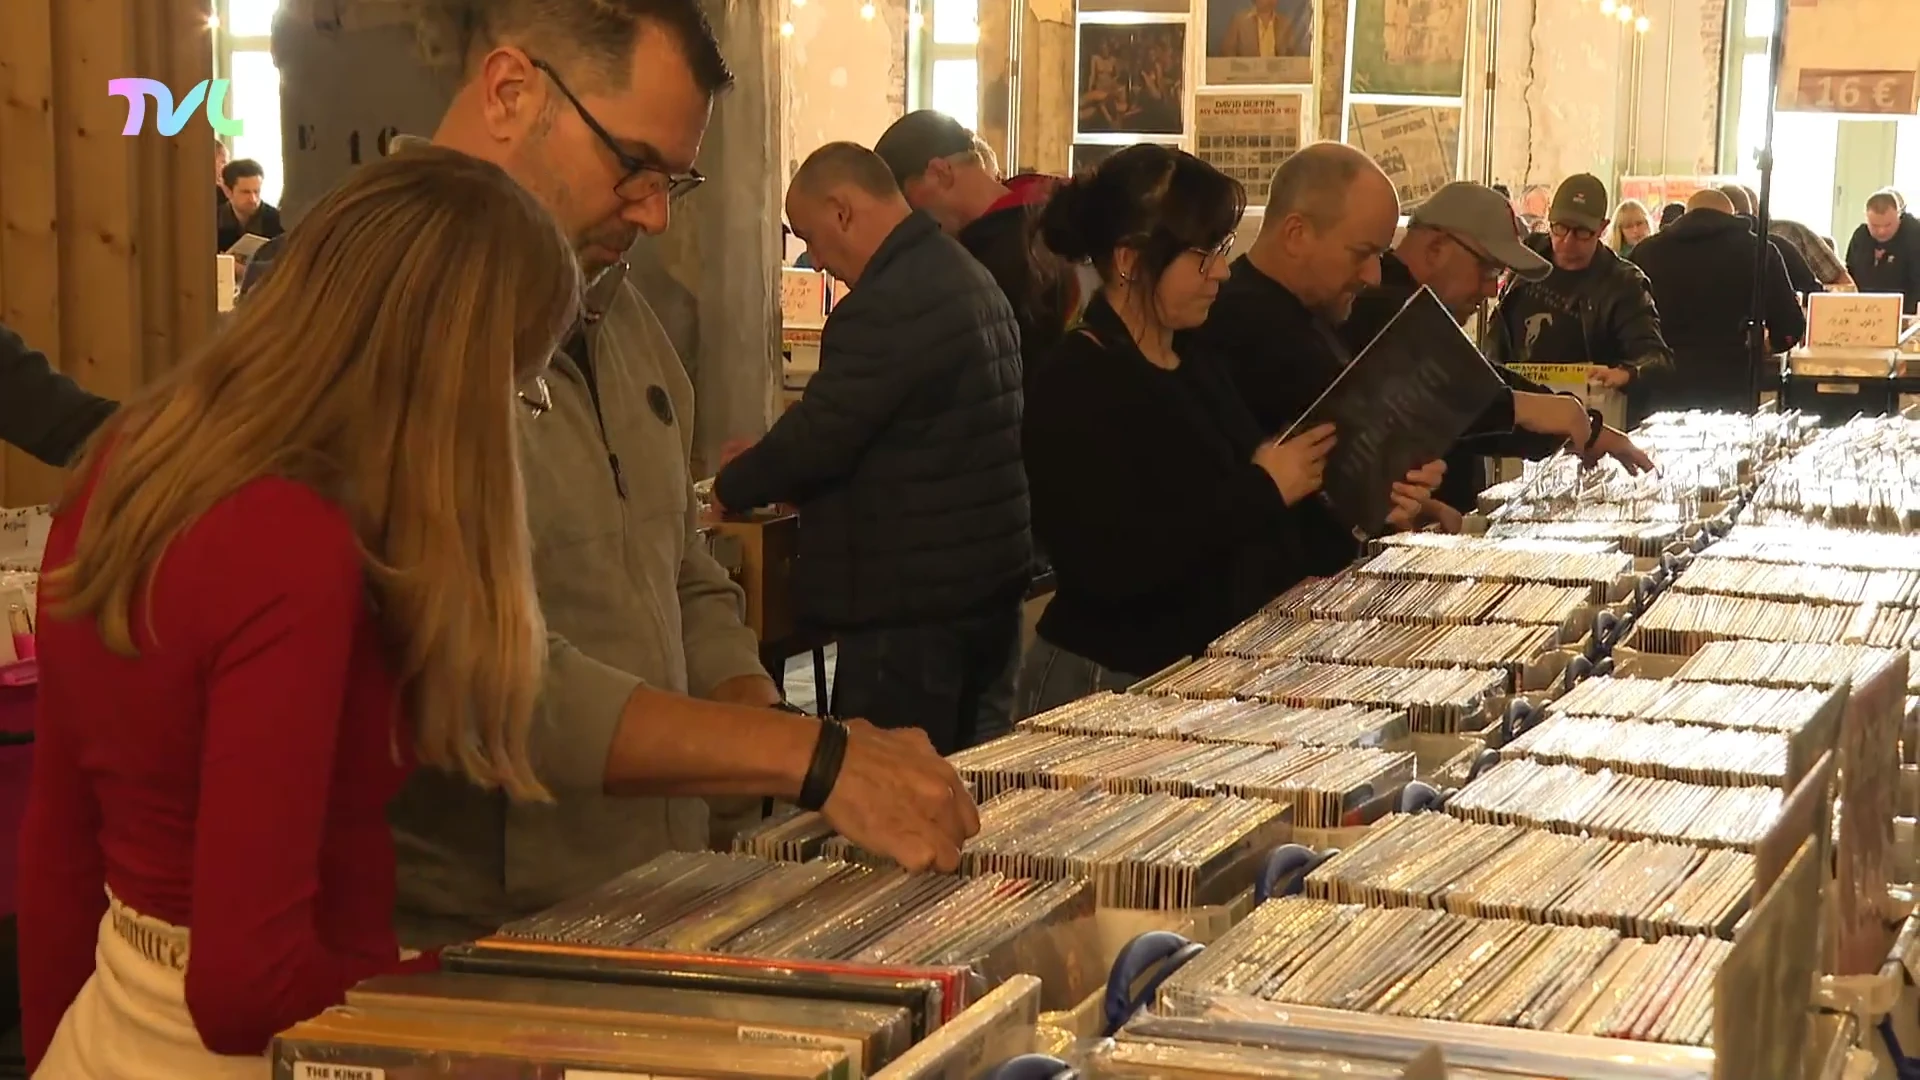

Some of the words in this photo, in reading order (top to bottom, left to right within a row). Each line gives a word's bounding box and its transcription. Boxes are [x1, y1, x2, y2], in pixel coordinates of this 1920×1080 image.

[1815, 76, 1860, 107] 16
[1215, 100, 1241, 108] DAVID
[1540, 365, 1569, 373] METAL
[305, 1066, 330, 1078] THE
[334, 1069, 373, 1080] KINKS
